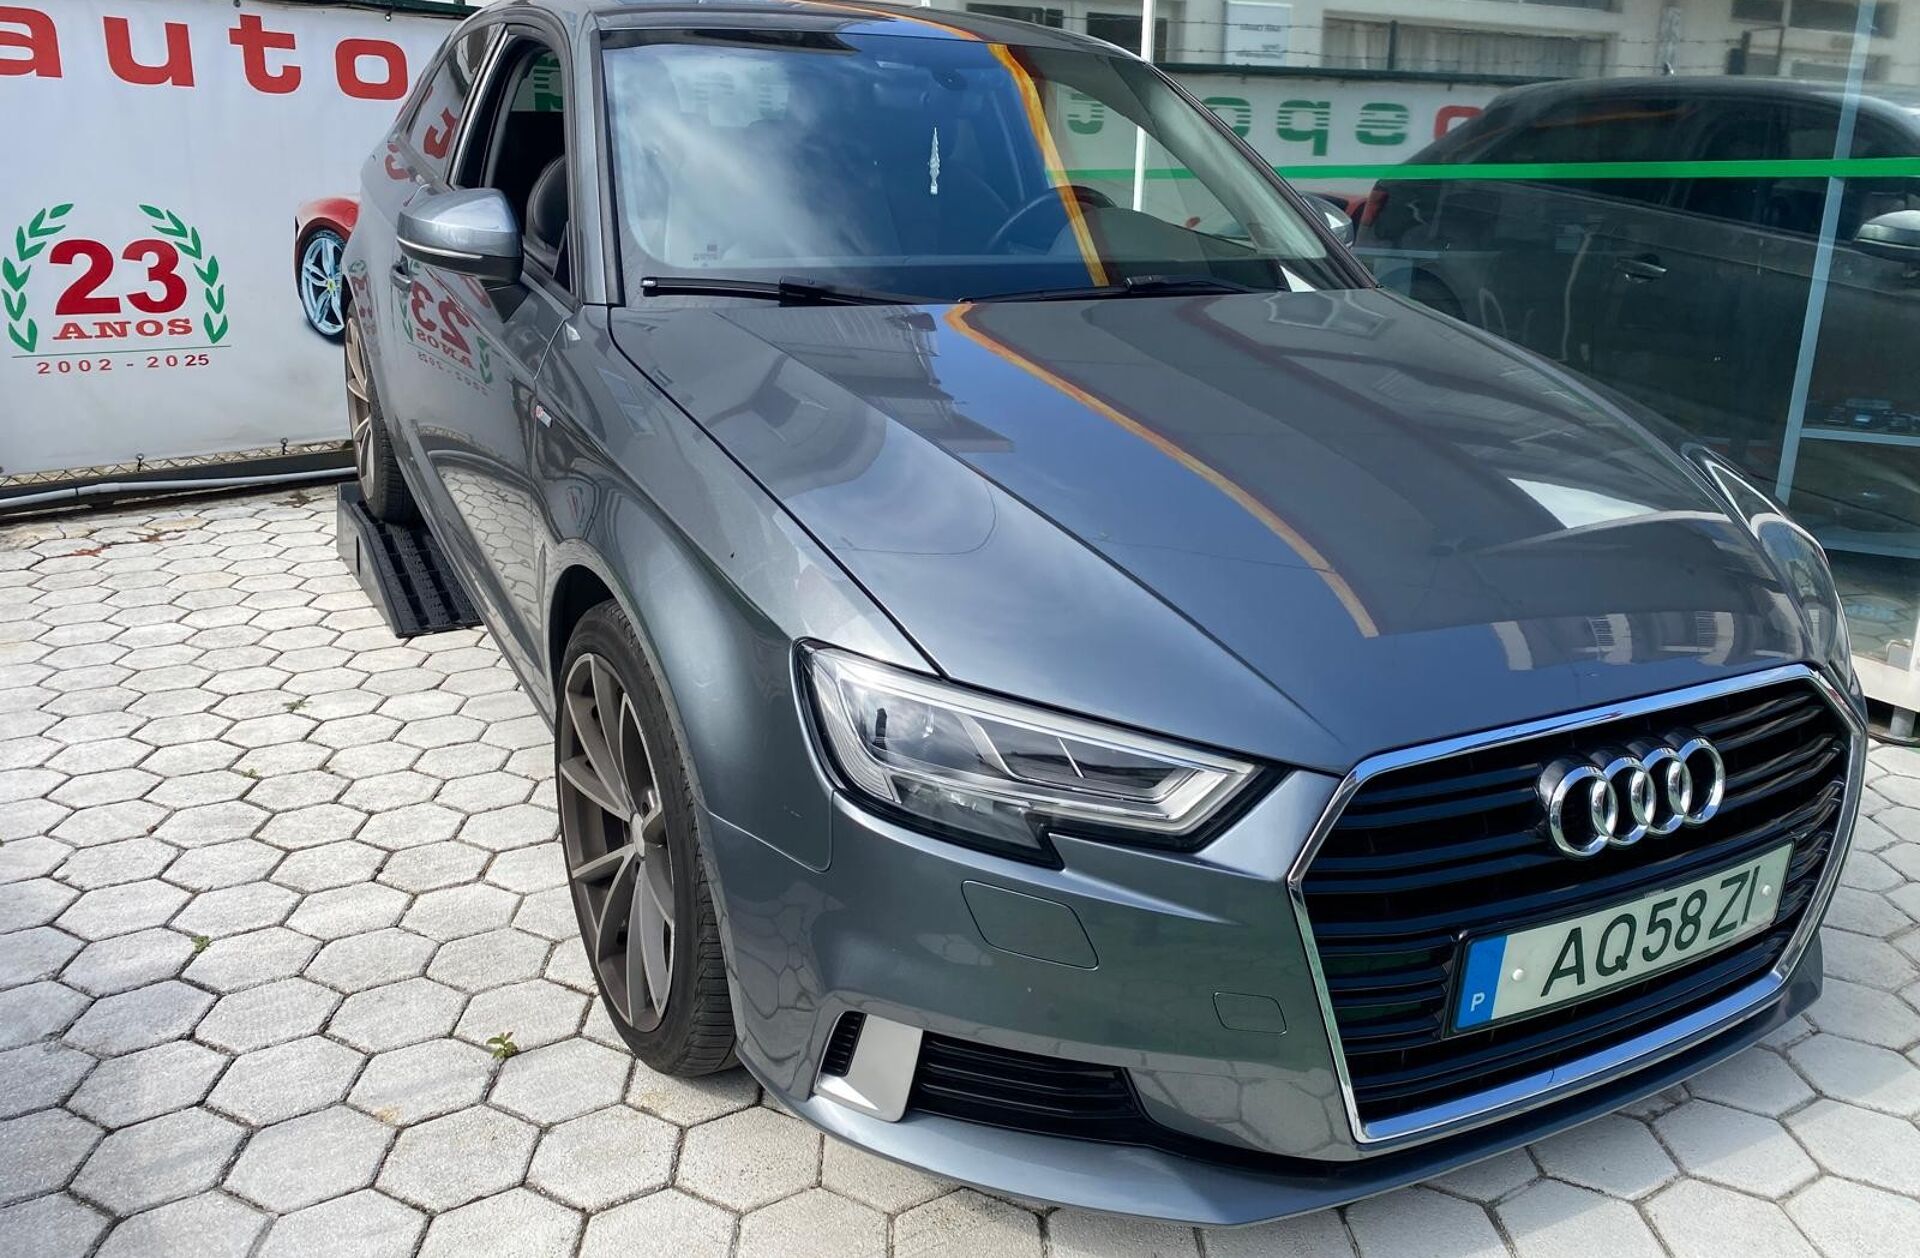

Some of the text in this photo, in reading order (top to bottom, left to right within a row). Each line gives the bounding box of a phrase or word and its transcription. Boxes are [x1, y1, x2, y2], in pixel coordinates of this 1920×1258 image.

[0, 7, 409, 100] auto
[49, 239, 187, 315] 23
[53, 318, 193, 340] ANOS
[37, 359, 112, 374] 2002
[147, 354, 210, 368] 2025
[1470, 992, 1485, 1012] P
